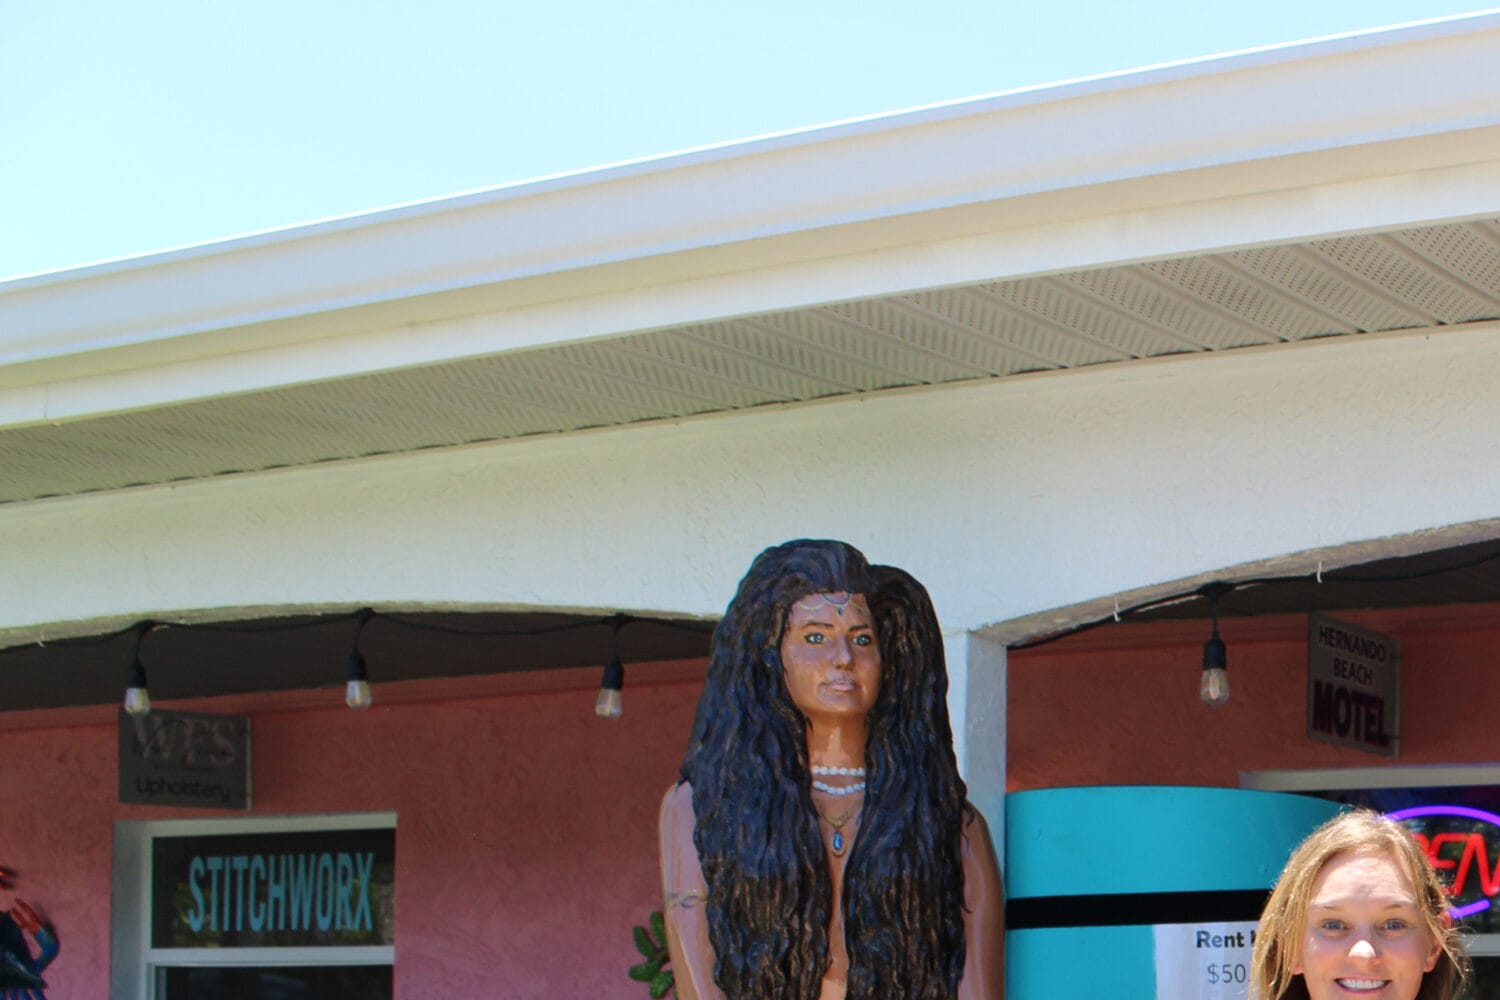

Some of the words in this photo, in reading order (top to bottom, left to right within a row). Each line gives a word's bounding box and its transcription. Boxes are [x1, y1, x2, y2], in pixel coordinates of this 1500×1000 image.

[1318, 624, 1386, 662] HERNANDO
[1333, 657, 1373, 685] BEACH
[1312, 679, 1389, 747] MOTEL
[136, 776, 231, 802] Upholstery
[188, 851, 375, 933] STITCHWORX
[1196, 930, 1245, 949] Rent
